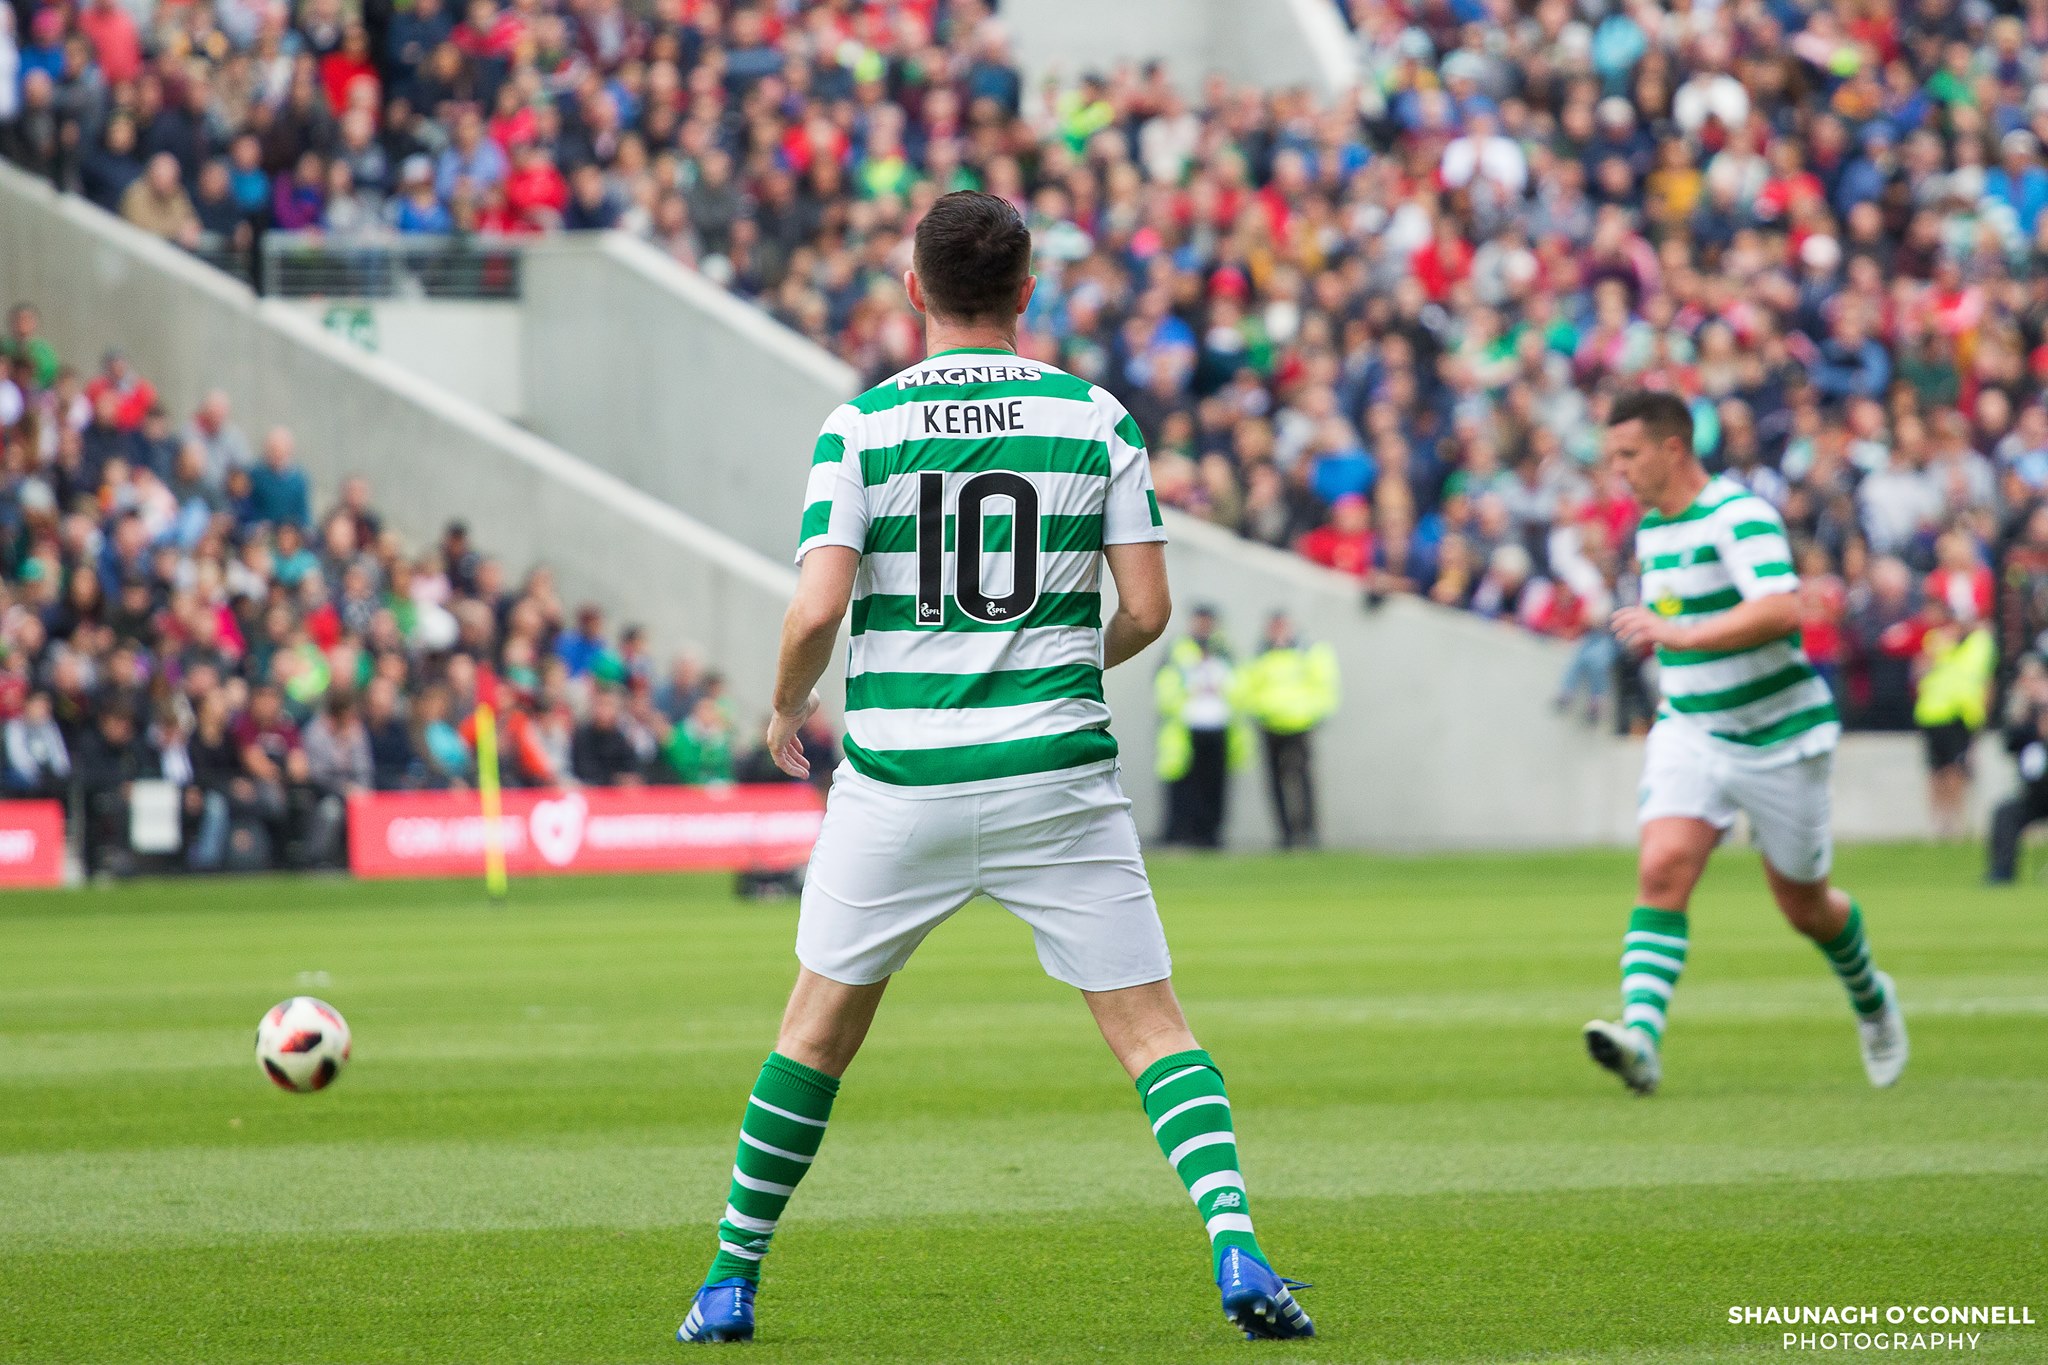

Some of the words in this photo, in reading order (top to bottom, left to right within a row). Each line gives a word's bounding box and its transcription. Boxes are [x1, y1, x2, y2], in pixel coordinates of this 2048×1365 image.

[896, 366, 1042, 391] MAGNERS
[923, 400, 1024, 434] KEANE
[916, 469, 1041, 625] 10
